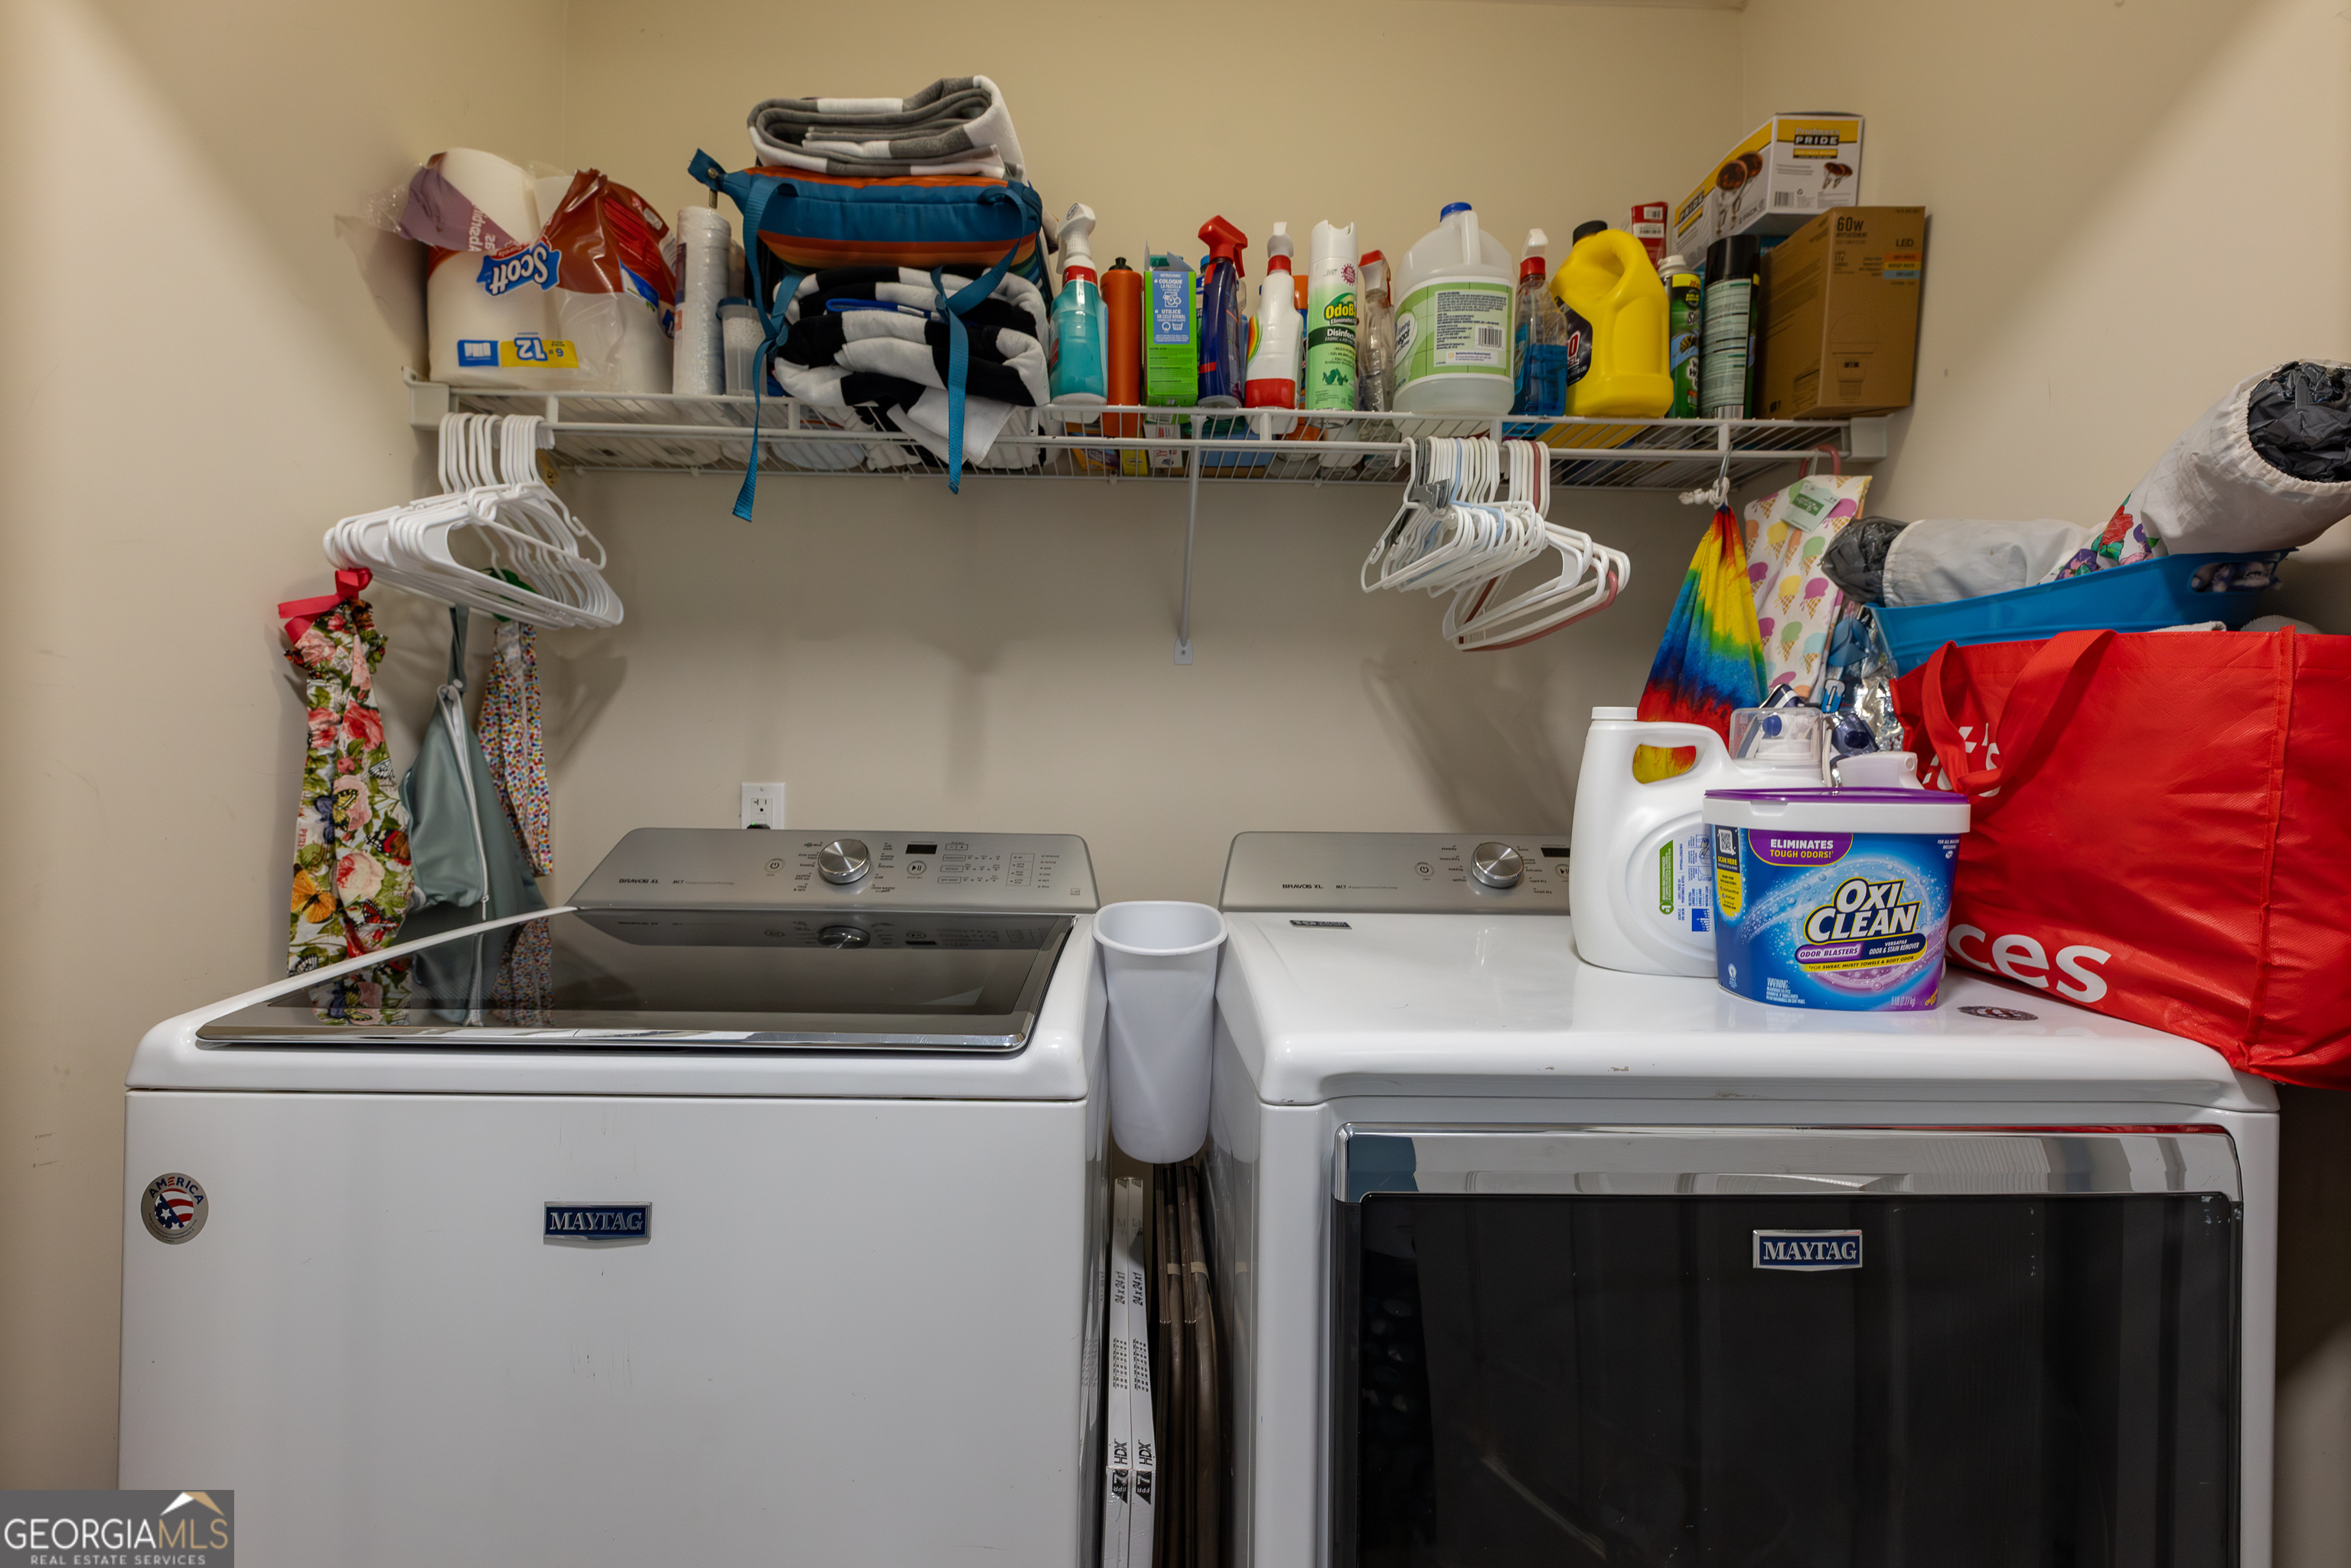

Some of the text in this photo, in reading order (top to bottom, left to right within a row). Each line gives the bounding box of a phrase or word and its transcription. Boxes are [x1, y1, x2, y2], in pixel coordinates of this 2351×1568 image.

[1795, 135, 1839, 145] PRIDE
[1896, 238, 1914, 247] LED
[489, 246, 549, 295] Scott
[515, 339, 546, 360] 12
[556, 347, 564, 357] 6
[1770, 839, 1834, 849] ELIMINATES
[1717, 856, 1737, 866] SCAN HERE
[1769, 849, 1798, 858] TOUGH
[1837, 879, 1901, 913] OXI
[1808, 905, 1917, 942] CLEAN
[1800, 947, 1858, 958] ODOR BLASTERS
[1899, 942, 1919, 951] REMOVER
[1945, 924, 2111, 1003] ces
[1767, 976, 1790, 989] WARNING:
[149, 1176, 204, 1205] AMERICA
[549, 1212, 643, 1231] MAYTAG
[1763, 1241, 1857, 1260] MAYTAG
[1114, 1440, 1128, 1465] HDX
[1138, 1441, 1153, 1466] HDX
[1137, 1475, 1150, 1485] 7
